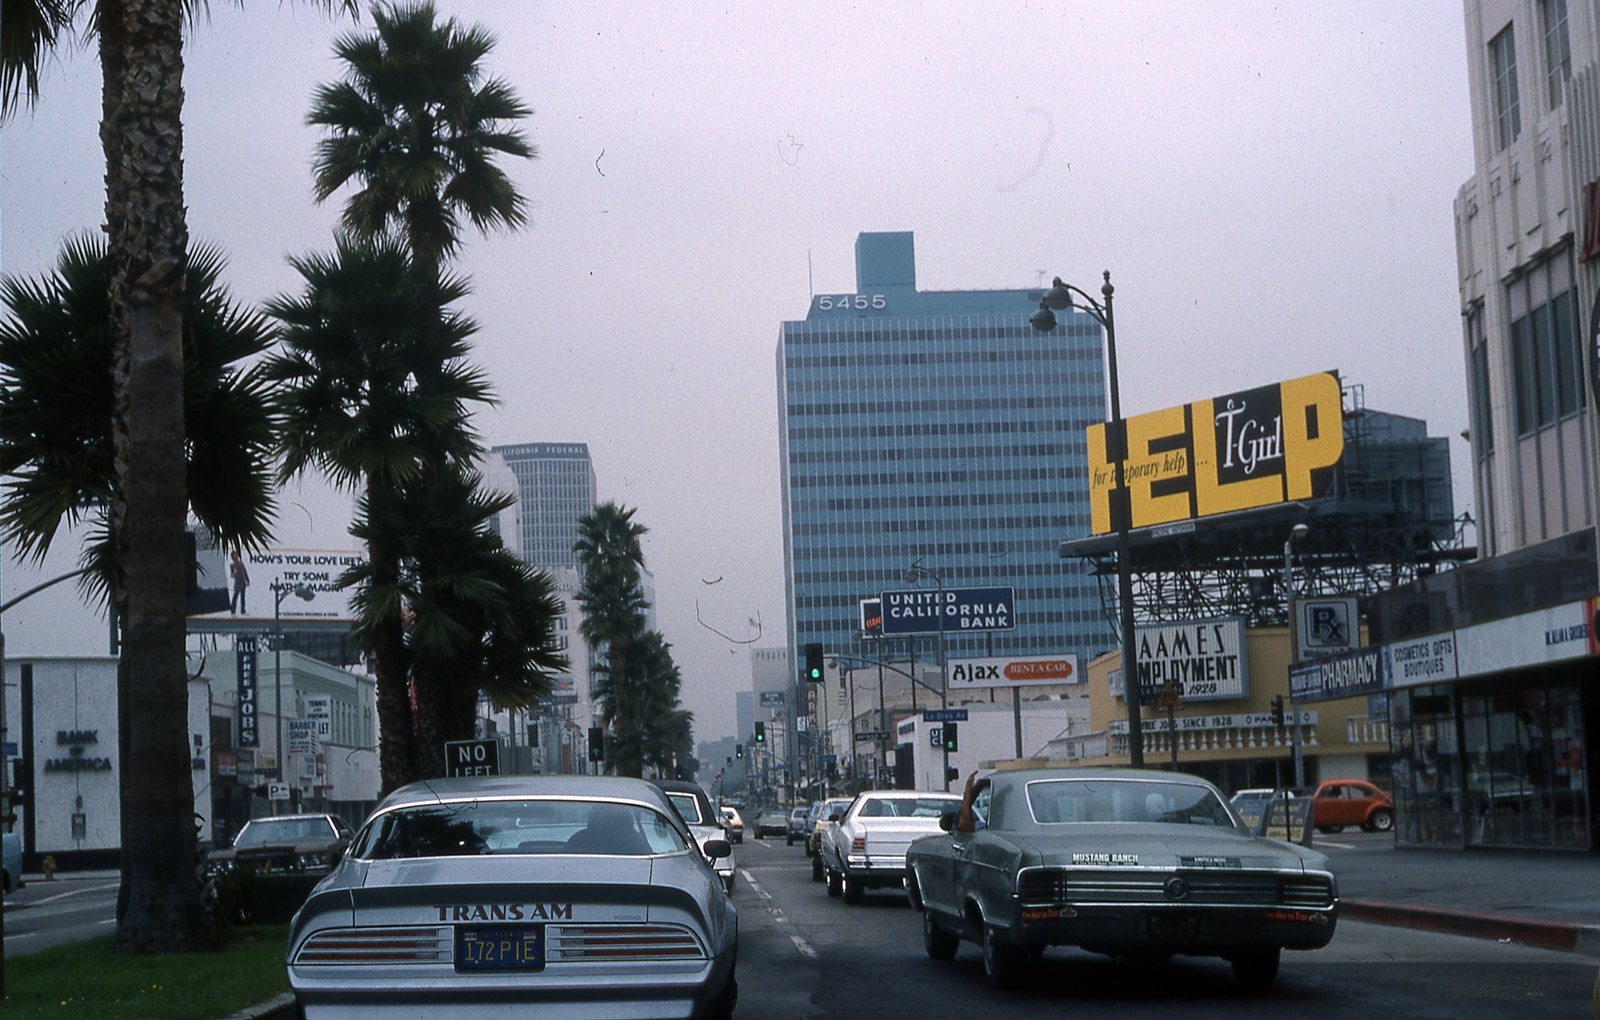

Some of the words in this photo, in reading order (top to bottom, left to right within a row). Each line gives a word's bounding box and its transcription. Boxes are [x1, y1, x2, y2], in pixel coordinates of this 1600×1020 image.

[819, 294, 886, 310] 5455
[1087, 372, 1344, 535] HELP
[1092, 469, 1107, 489] for
[1163, 451, 1185, 473] help
[250, 555, 282, 564] HOW'S
[285, 556, 311, 565] YOUR
[314, 556, 337, 565] LOVE
[284, 572, 300, 580] TRY
[303, 572, 329, 581] SOME
[890, 592, 957, 605] UNITED
[890, 603, 1008, 618] CALIFORNIA
[960, 617, 1008, 629] BANK
[238, 642, 254, 651] ALL
[1139, 625, 1225, 659] AAMES
[1395, 642, 1429, 661] COSMETICS
[1433, 639, 1451, 656] GIFTS
[953, 664, 999, 682] Ajax
[1010, 664, 1034, 673] RENT
[1038, 664, 1045, 672] A
[1046, 663, 1066, 672] CAR
[1137, 656, 1237, 686] MPLOYMENT
[1322, 654, 1378, 690] PHARMACY
[1404, 658, 1444, 677] BOUTIQUES
[1188, 683, 1217, 695] 1928
[241, 689, 254, 743] JOBS
[937, 711, 953, 719] Brea
[1141, 721, 1155, 730] FREE
[1159, 720, 1178, 730] JOS
[1183, 717, 1206, 728] SINCE
[1212, 715, 1232, 726] 1928
[289, 721, 316, 730] BARBER
[56, 730, 98, 745] BANK
[289, 731, 308, 740] SHOP
[459, 745, 486, 762] NO
[44, 758, 112, 773] AMERICA
[270, 786, 279, 797] P
[1072, 853, 1109, 862] MUSTANG
[1112, 854, 1138, 862] RANCH
[434, 904, 524, 921] TRANS
[531, 904, 572, 921] AM
[465, 941, 495, 961] 172
[500, 940, 535, 961] PIE
